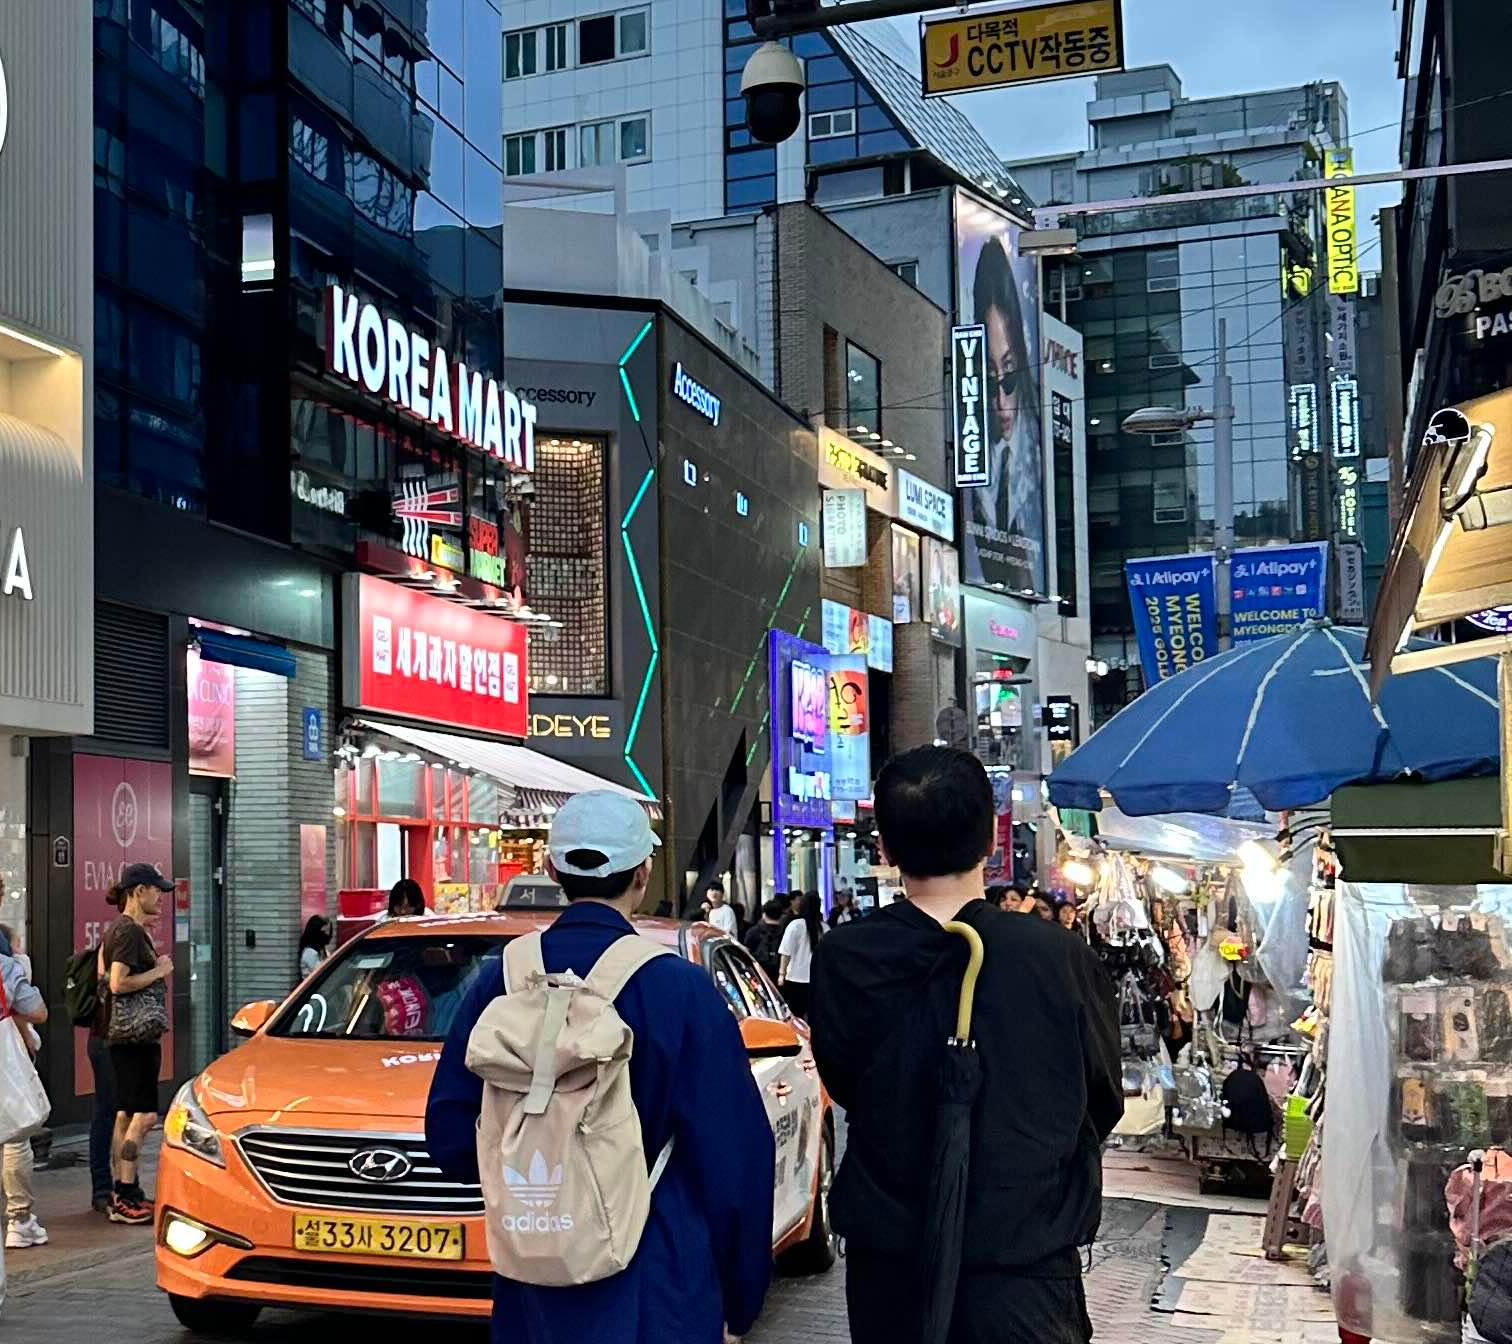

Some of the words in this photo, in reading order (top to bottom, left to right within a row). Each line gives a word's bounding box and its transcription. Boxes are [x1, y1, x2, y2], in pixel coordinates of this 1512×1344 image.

[967, 17, 1019, 43] 다목적
[967, 26, 1112, 78] CCTV작동중
[1332, 229, 1354, 283] OPTIC
[332, 284, 453, 433] KOREA
[458, 361, 537, 473] MART
[674, 361, 722, 427] Accessory
[515, 386, 597, 406] ccessory
[960, 338, 981, 474] VINTAGE
[1234, 610, 1299, 623] WELCOME
[84, 860, 114, 891] EVIA
[323, 1221, 373, 1249] 33사
[380, 1224, 451, 1254] 3207
[502, 1211, 574, 1233] adidas
